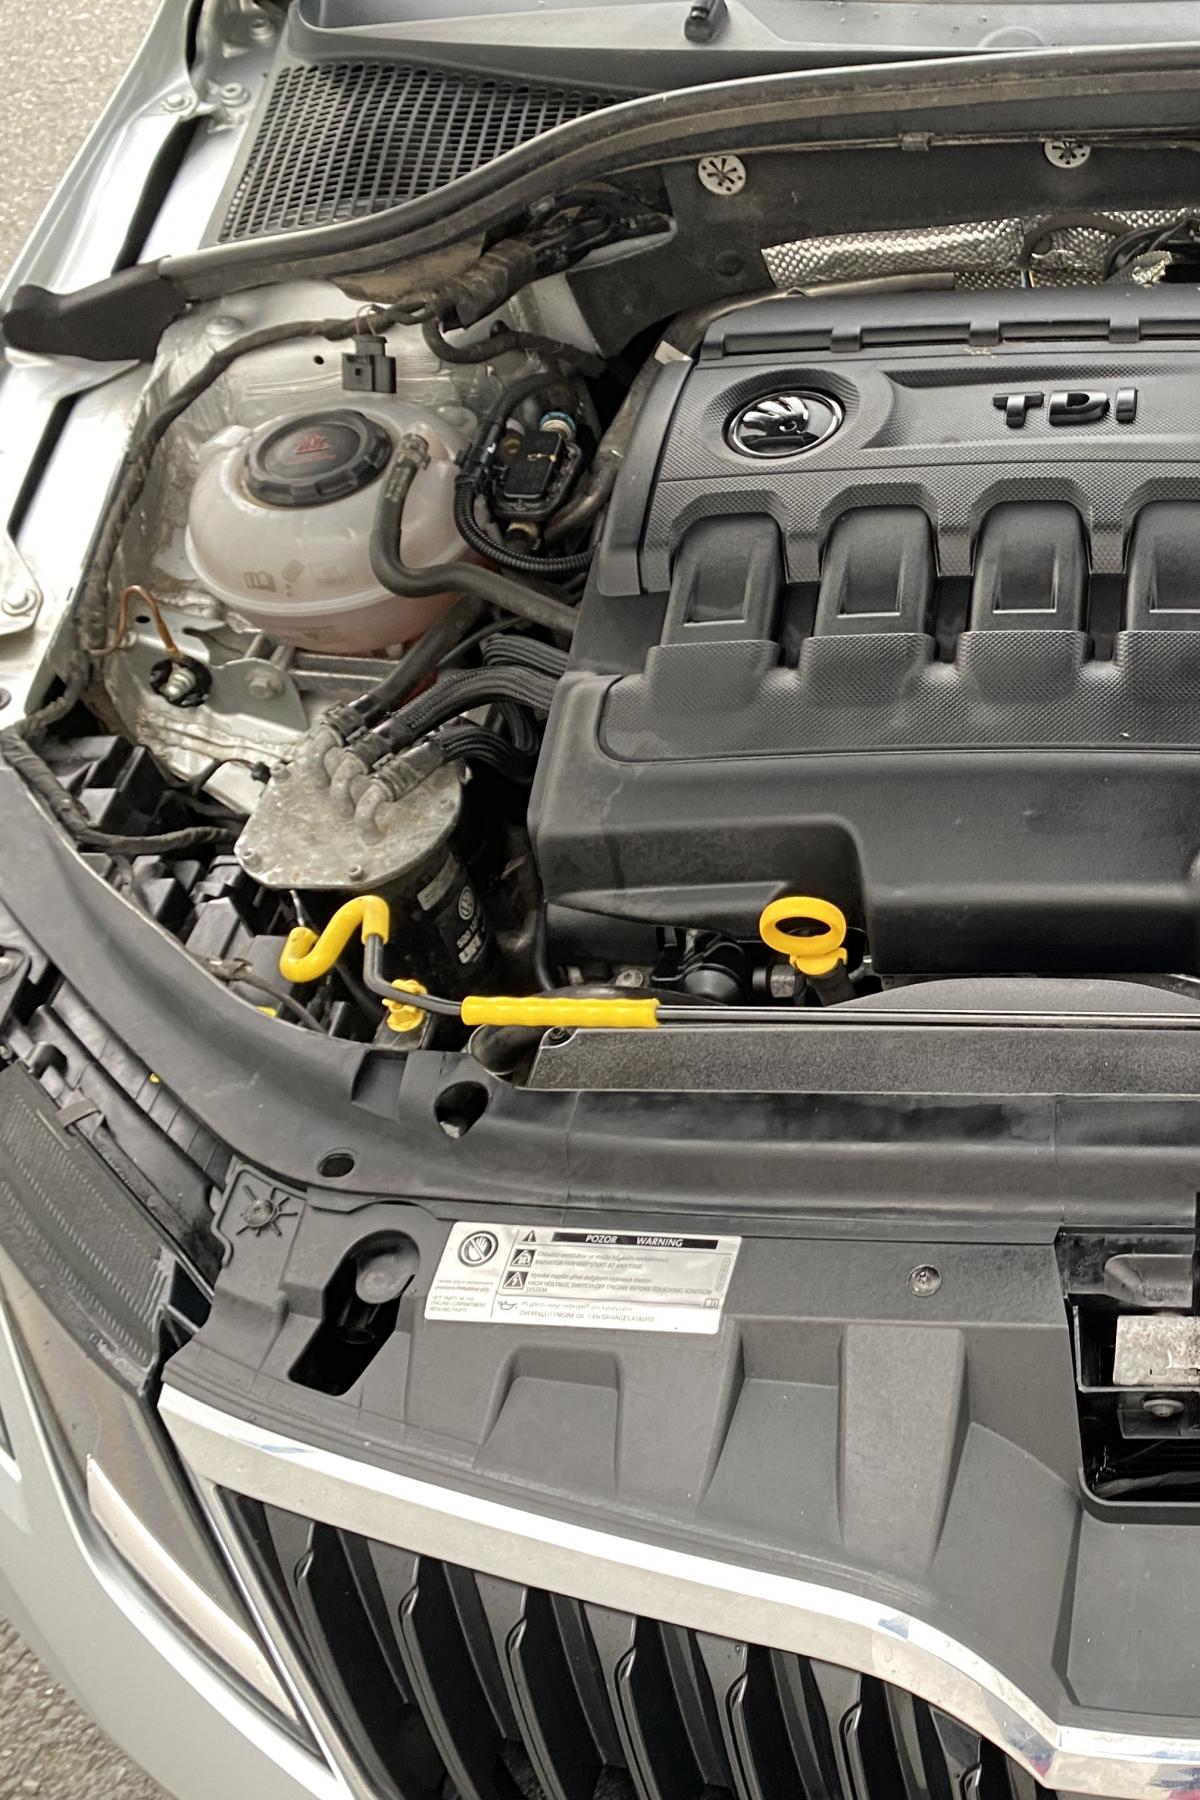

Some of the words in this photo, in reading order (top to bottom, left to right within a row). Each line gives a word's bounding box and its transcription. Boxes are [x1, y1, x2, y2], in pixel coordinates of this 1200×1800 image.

[993, 387, 1138, 429] TDI
[585, 1234, 618, 1244] POZOR
[635, 1236, 684, 1247] WARNING
